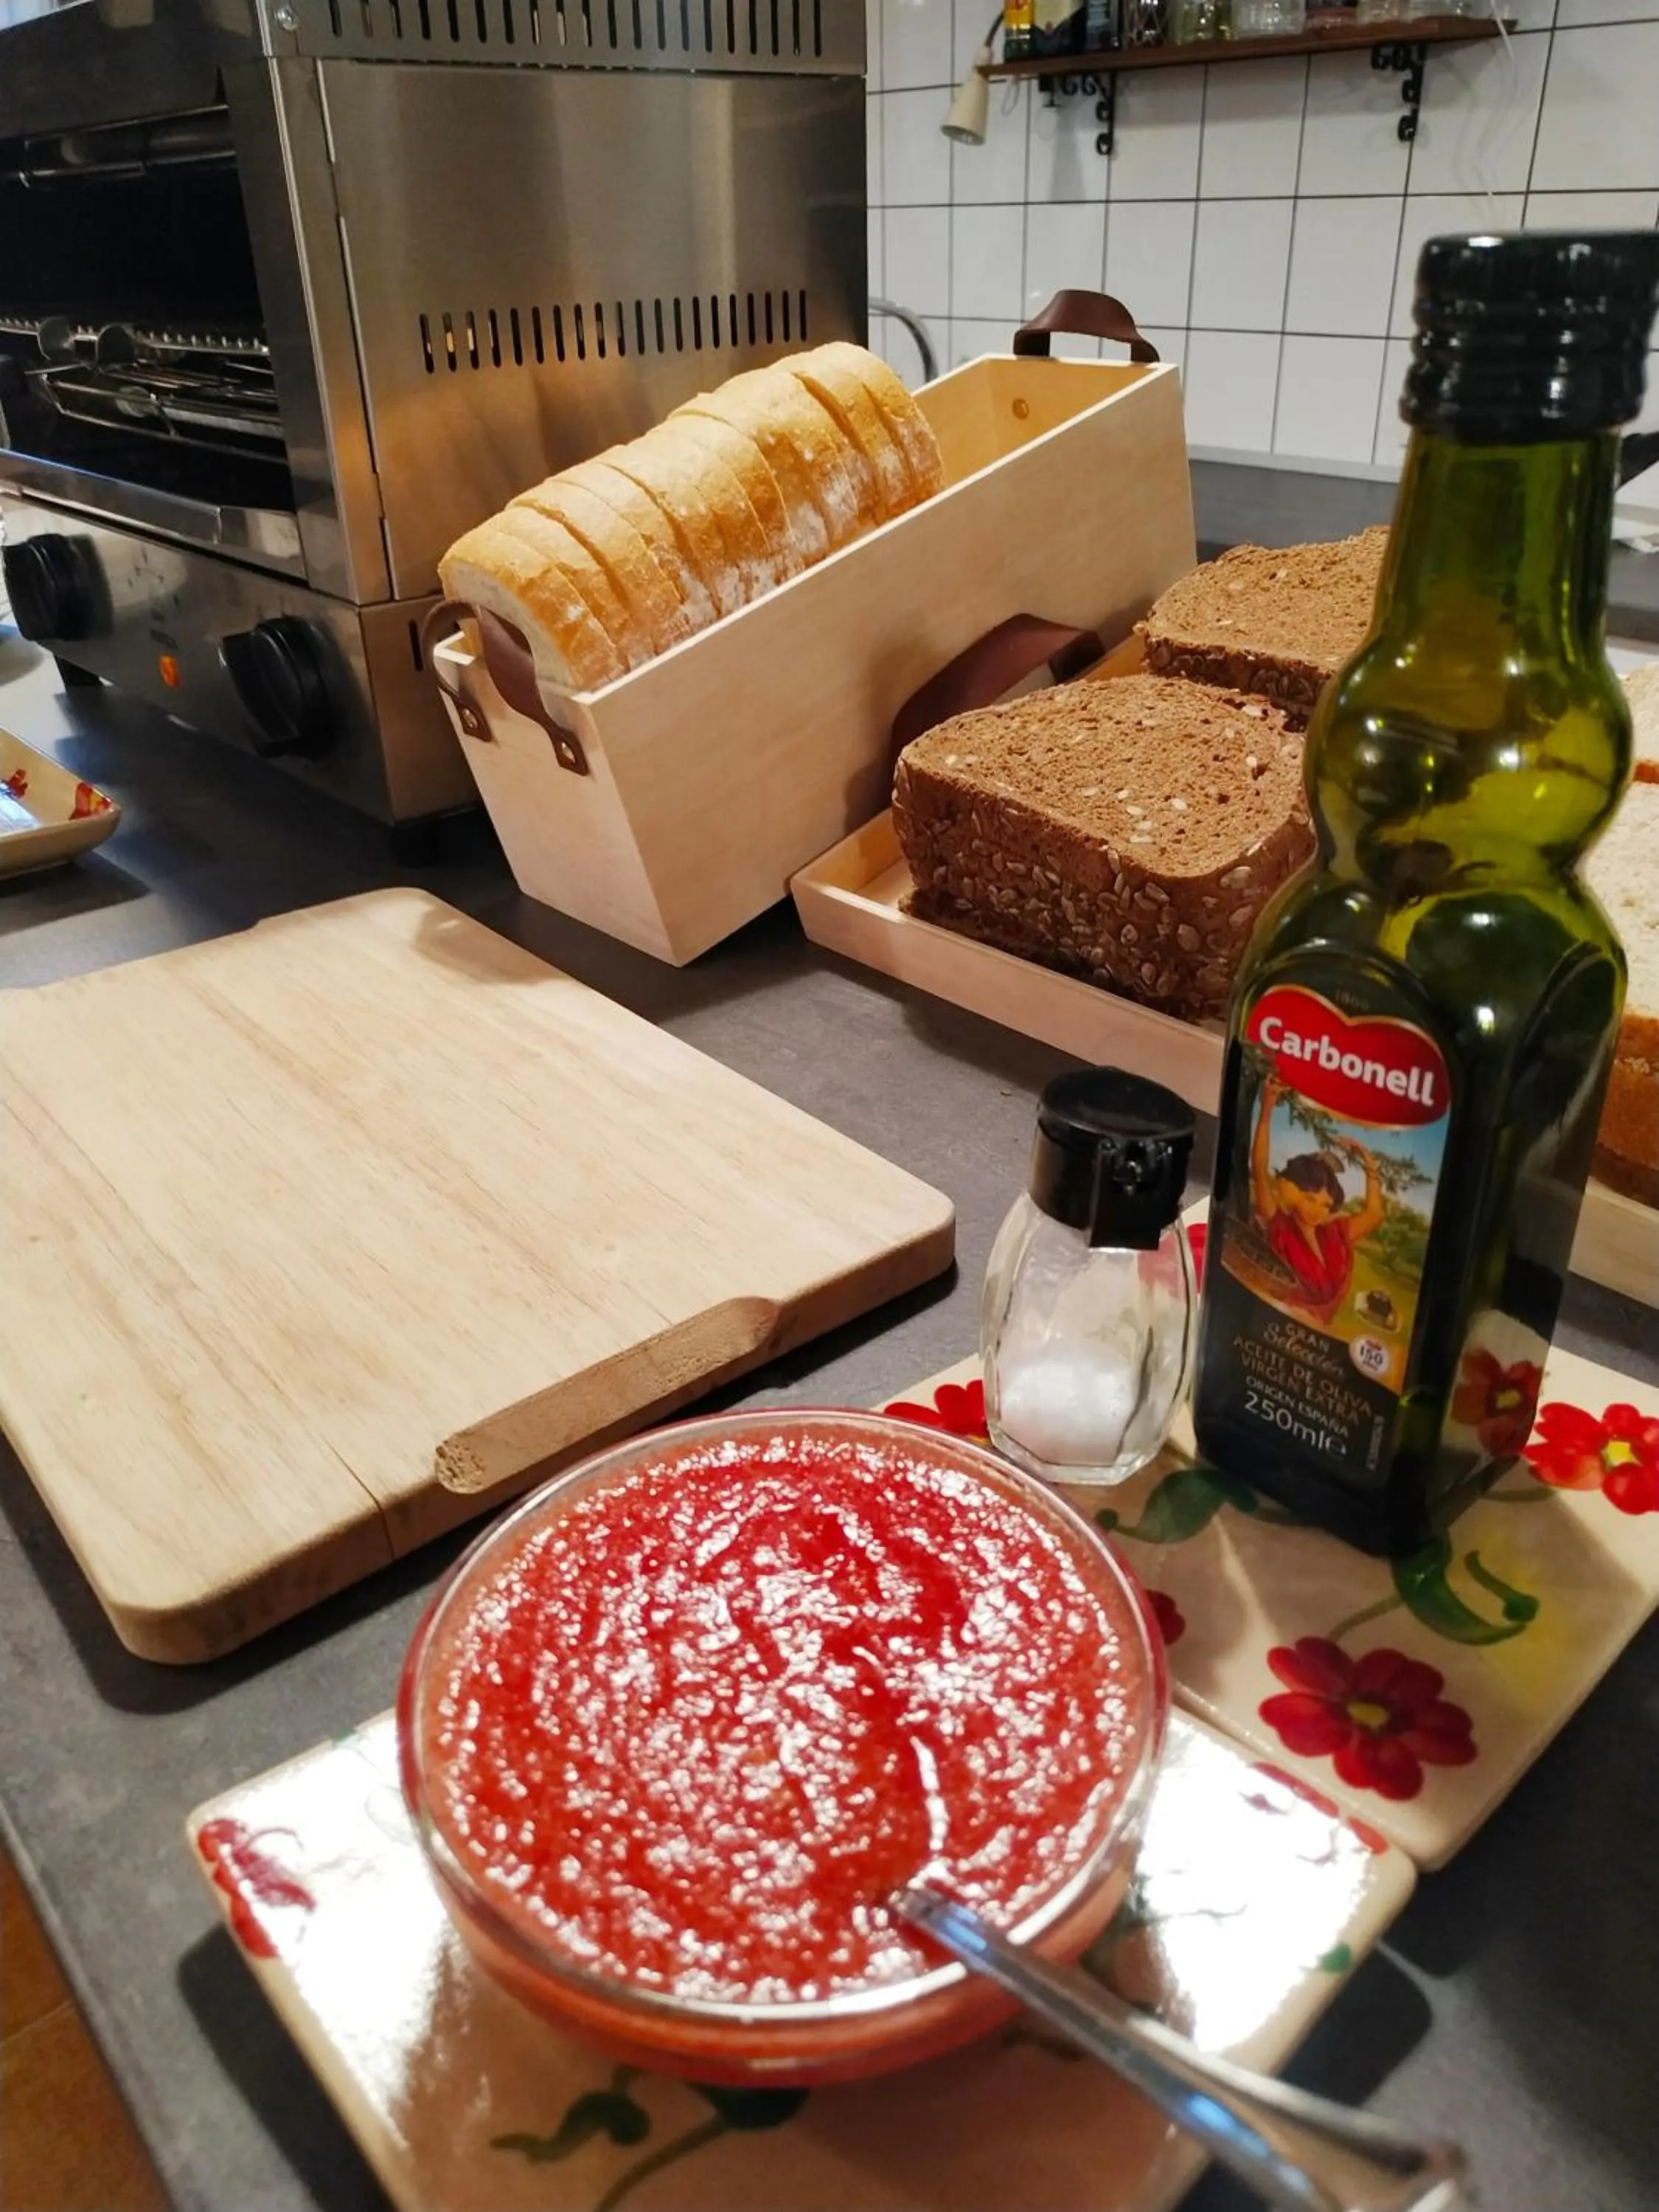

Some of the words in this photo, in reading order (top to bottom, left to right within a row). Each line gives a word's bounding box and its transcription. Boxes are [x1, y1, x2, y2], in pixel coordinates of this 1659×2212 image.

[1259, 1017, 1434, 1107] Carbonell
[1233, 1335, 1287, 1369] ACEITE
[1293, 1363, 1314, 1385] DE
[1321, 1378, 1372, 1417] OLIVA
[1241, 1351, 1300, 1394] VIRGEN
[1305, 1382, 1360, 1427] EXTRA
[1245, 1375, 1294, 1408] ORIGEN
[1360, 1345, 1385, 1366] 150
